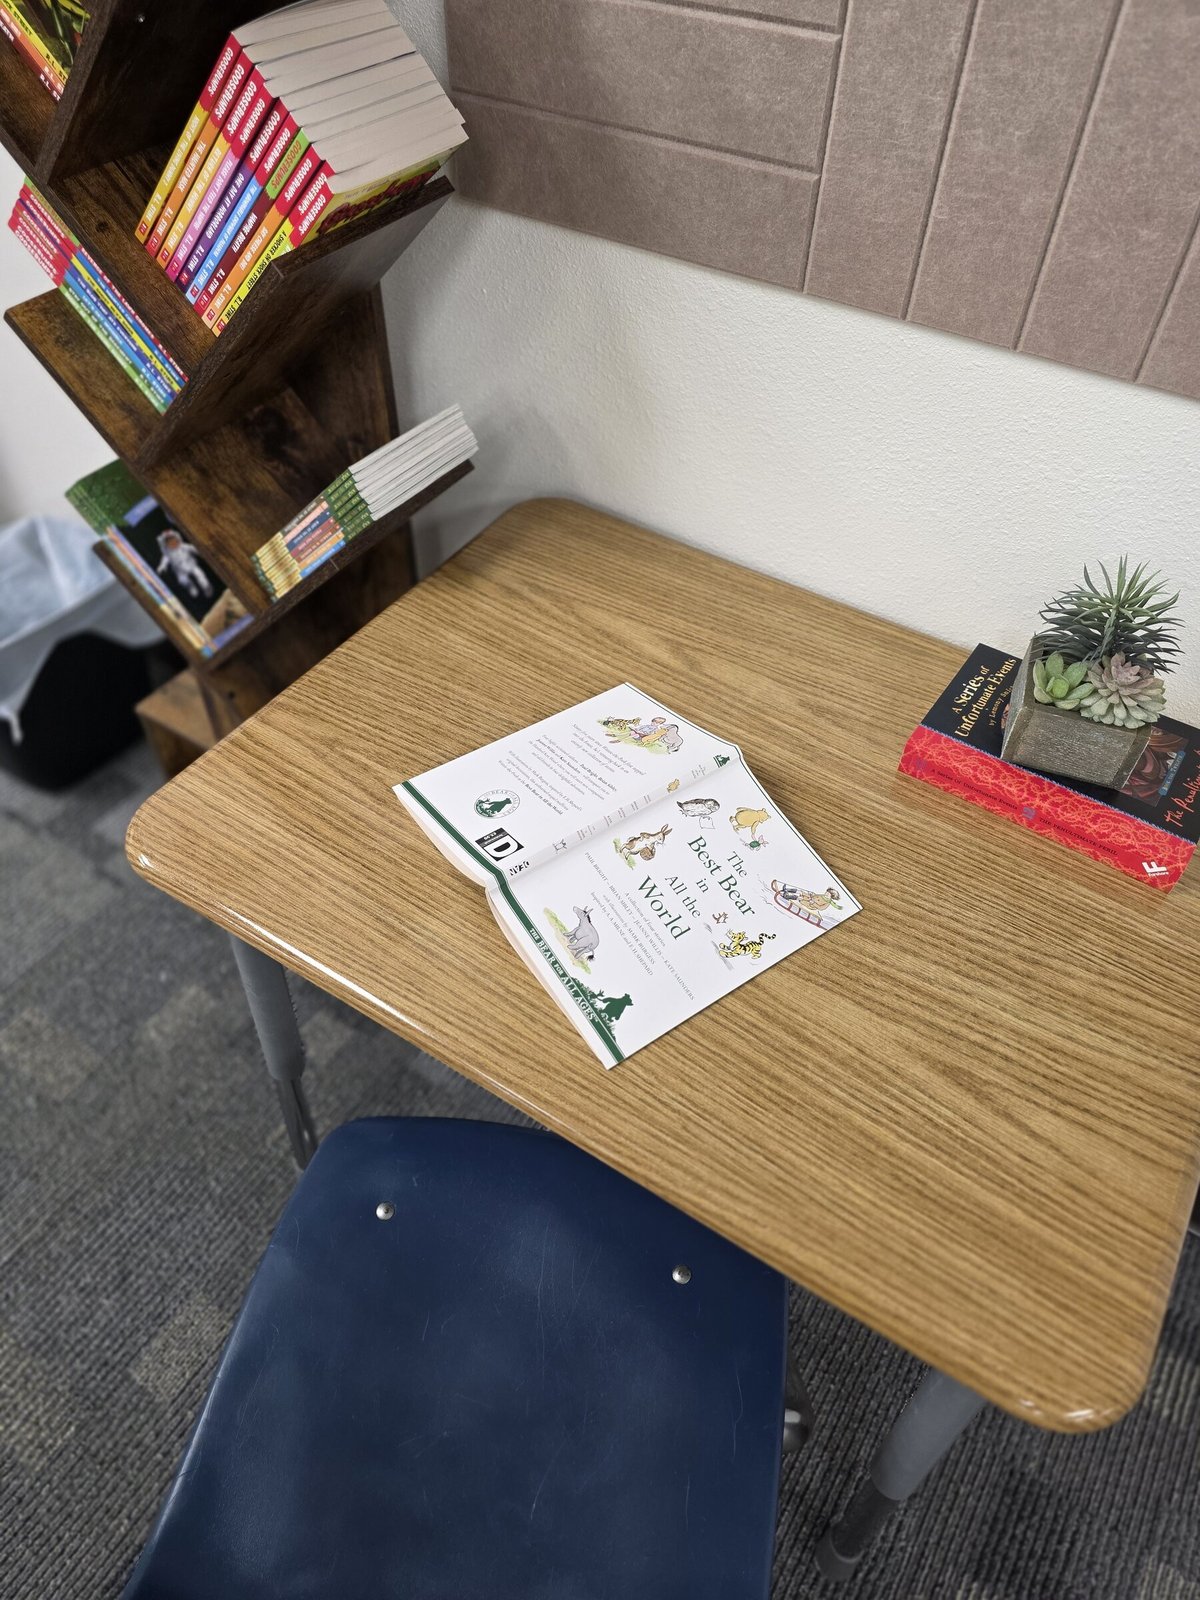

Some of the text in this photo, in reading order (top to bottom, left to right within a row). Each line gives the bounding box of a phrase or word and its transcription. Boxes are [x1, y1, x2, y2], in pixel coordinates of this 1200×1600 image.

[208, 48, 233, 94] GOOSEBUMPS
[157, 65, 244, 235] GOOSEBUMPS THE HAUNTED MASK R.L. STINE
[168, 82, 256, 248] GOOSEBUMPS RETURN OF THE MUMMY R.L. STINE
[180, 141, 188, 151] THE
[264, 129, 290, 171] GOOSEBUMPS
[153, 193, 162, 204] R.L.
[177, 99, 265, 260] GOOSEBUMPS PLEASE DON'T FEED THE VAMPIRE R.L. STINE
[188, 112, 280, 271] GOOSEBUMPS ONE DAY AT HORRORLAND R.L. STINE
[249, 185, 257, 195] THE
[285, 159, 312, 200] GOOSEBUMPS
[299, 172, 326, 213] GOOSEBUMPS
[26, 200, 60, 243] GOOSEBUMPS
[30, 194, 64, 237] GOOSEBUMPS
[146, 204, 156, 221] STINE
[208, 141, 301, 294] GOOSEBUMPS VAMPIRE BREATH R.L. STINE
[299, 195, 326, 234] GOOSEBUMPS
[18, 226, 56, 274] GOOSEBUMPS
[19, 217, 53, 259] GOOSEBUMPS
[260, 227, 268, 238] SAY
[269, 235, 284, 255] SHOCKER
[15, 230, 53, 278] GOOSEBUMPS
[205, 259, 214, 270] R.L.
[256, 260, 267, 275] SHOCK
[265, 253, 271, 262] ON
[197, 269, 208, 285] STINE
[223, 283, 232, 294] R.L.
[247, 273, 258, 289] STREET
[23, 211, 57, 253] GOOSEBUMPS
[146, 362, 154, 373] R.L.
[157, 376, 171, 392] STINE
[81, 248, 183, 375] REVENGE OF THE LAWN GNOMES R.L. STINE
[214, 293, 225, 308] STINE
[225, 305, 236, 319] STINE
[234, 296, 242, 305] R.L.
[952, 665, 990, 715] A Series of
[954, 659, 1017, 737] Unfortunate Events
[988, 698, 1005, 718] Lemony
[1039, 817, 1050, 825] THE
[1053, 824, 1096, 846] PENULTIMATE
[1098, 844, 1117, 855] PERIL
[1164, 809, 1184, 827] The
[593, 864, 608, 881] BRIGHT
[688, 836, 754, 914] Best Bear
[727, 851, 747, 876] The
[665, 876, 700, 916] All the
[696, 878, 709, 893] in
[639, 877, 689, 938] World
[530, 928, 596, 1020] THE BEAR FOR ALL AGES
